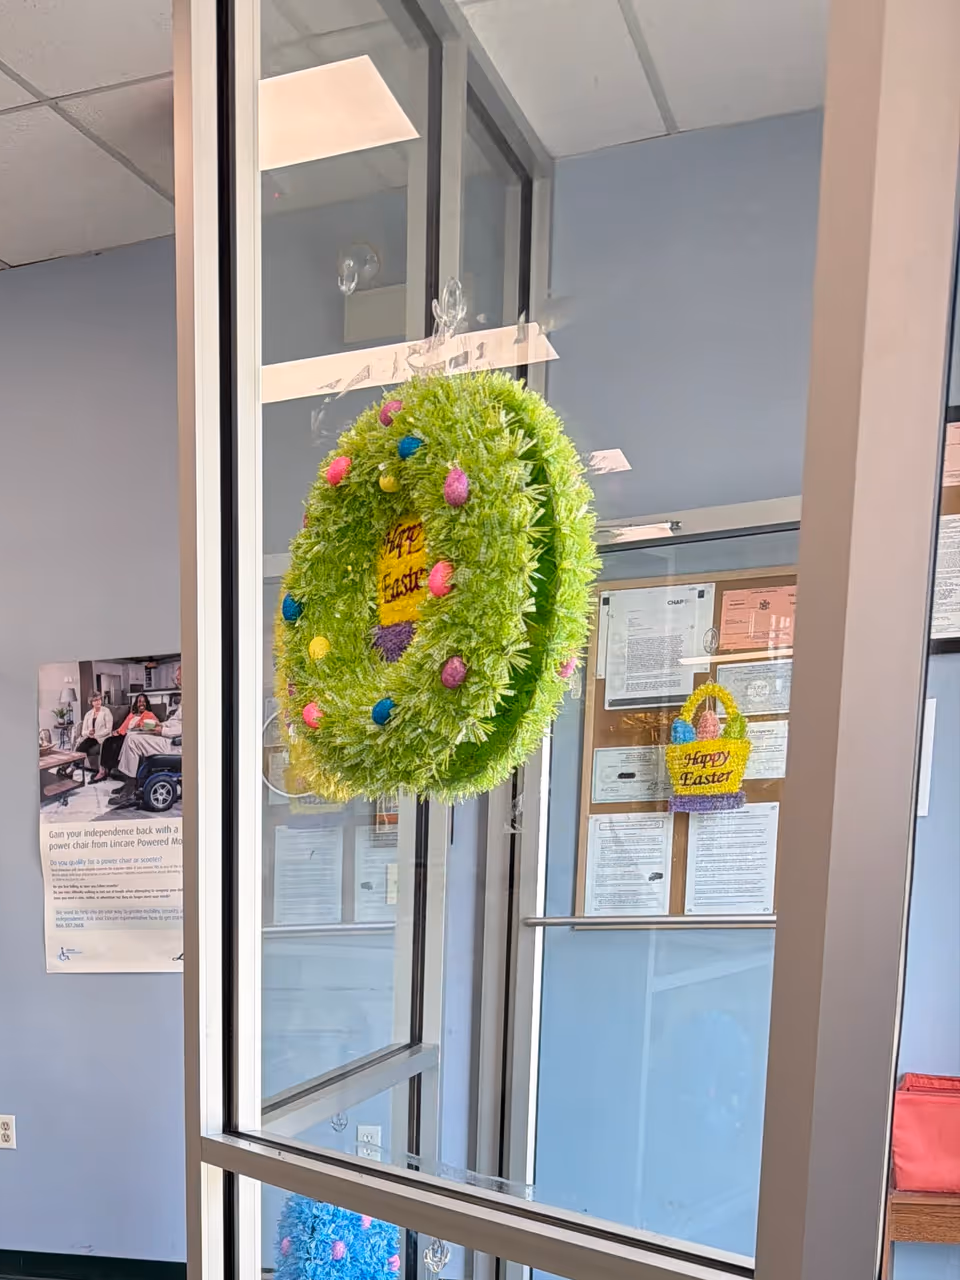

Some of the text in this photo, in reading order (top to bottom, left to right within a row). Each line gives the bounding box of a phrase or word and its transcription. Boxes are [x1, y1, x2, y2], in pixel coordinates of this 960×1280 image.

[683, 750, 731, 769] Happy
[680, 770, 734, 787] Easter
[49, 830, 65, 839] Gain
[66, 830, 82, 840] your
[84, 827, 134, 839] independence
[136, 826, 153, 836] back
[155, 825, 172, 835] with
[49, 841, 71, 852] power
[72, 840, 89, 850] chair
[91, 839, 108, 849] from
[109, 838, 135, 848] Lincare
[137, 836, 169, 847] Powered
[101, 858, 118, 866] power
